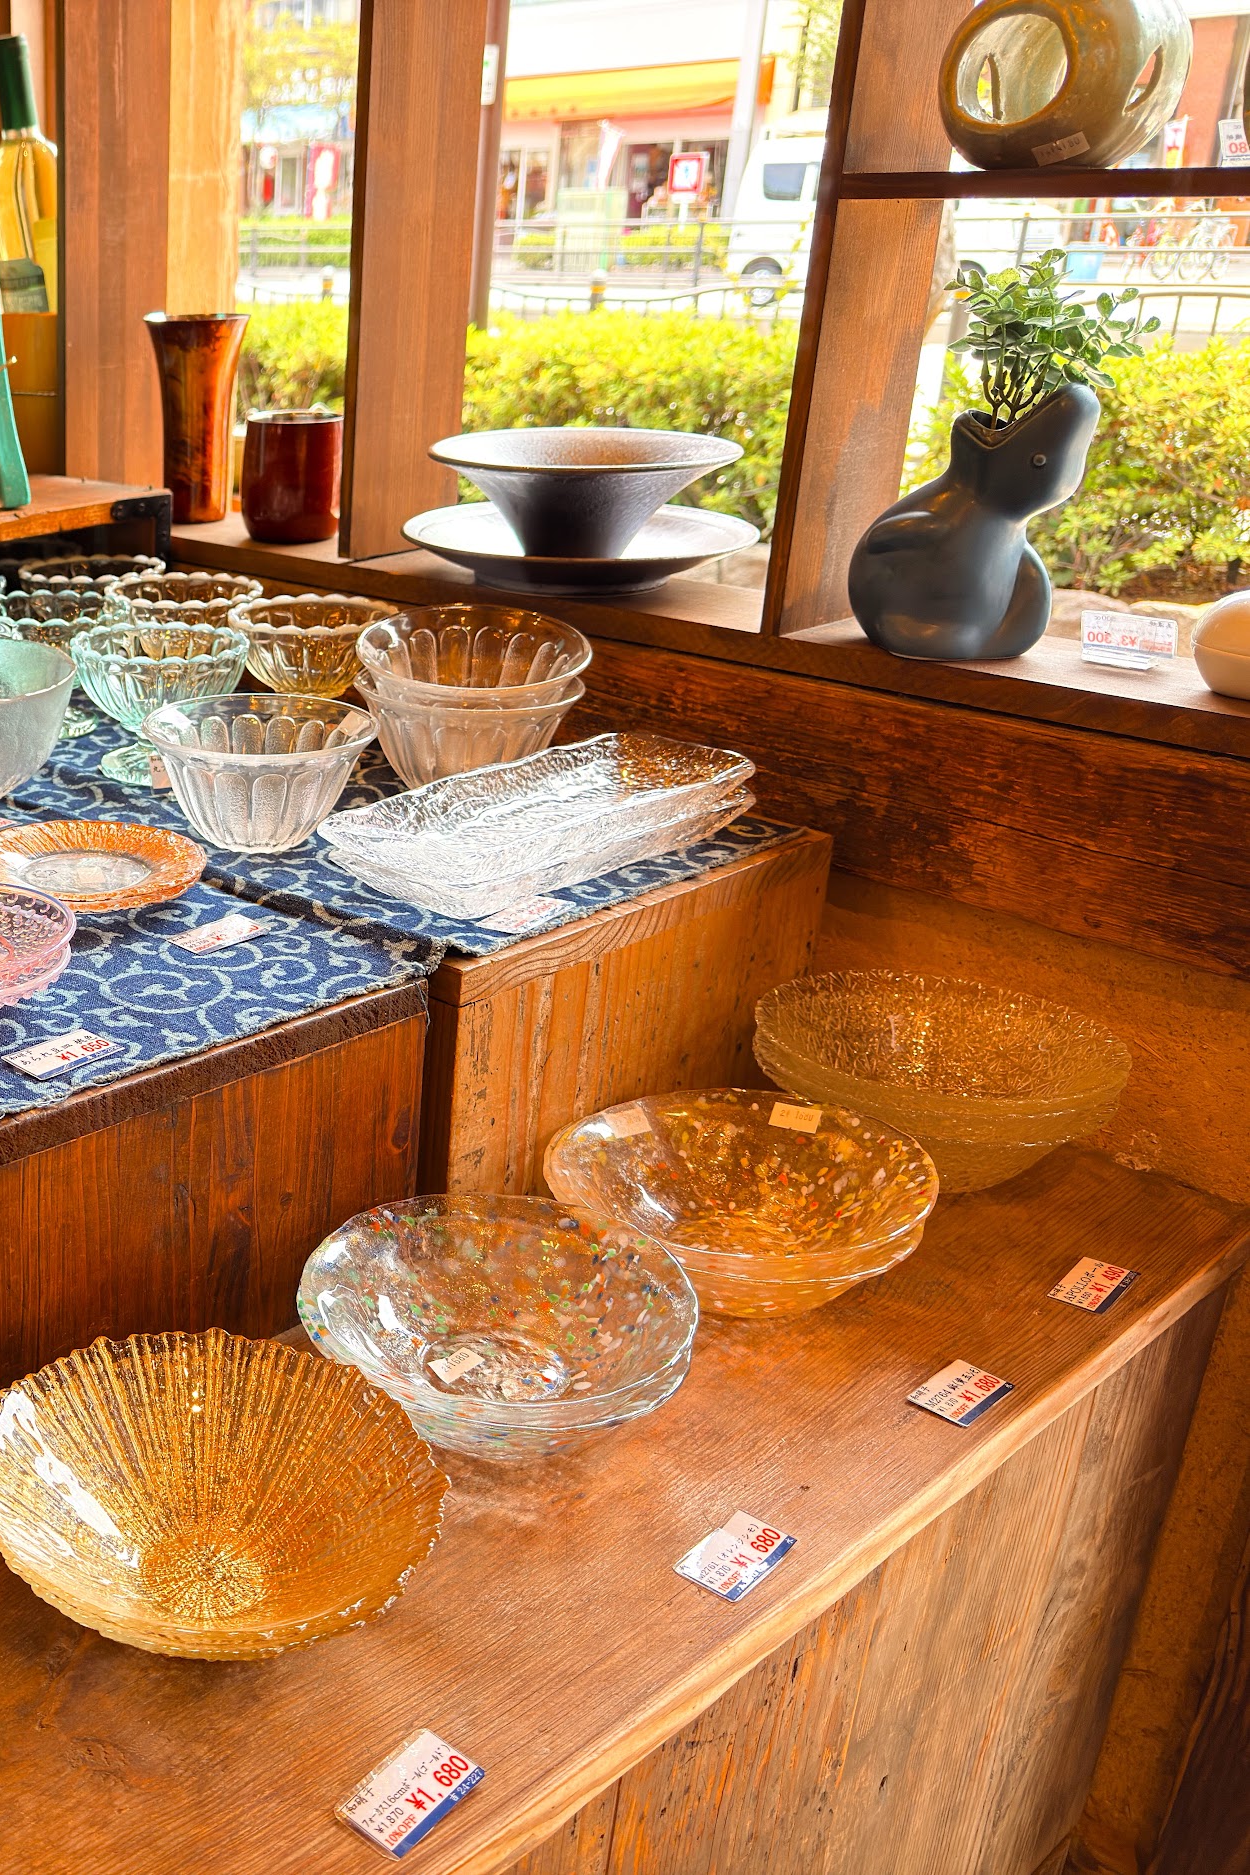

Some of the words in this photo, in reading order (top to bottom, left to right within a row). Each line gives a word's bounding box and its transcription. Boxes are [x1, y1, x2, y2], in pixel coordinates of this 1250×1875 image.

[55, 1039, 110, 1061] ¥1,650
[1089, 1266, 1125, 1293] ¥1,490
[925, 1389, 952, 1409] M2764
[958, 1374, 1001, 1403] ¥1,680
[730, 1528, 781, 1568] ¥1,680
[706, 1565, 731, 1585] ¥1,870
[718, 1570, 743, 1593] 10%OFF
[405, 1755, 469, 1811] ¥1,680
[456, 1769, 483, 1795] 24-227
[345, 1787, 374, 1815] 和硝子
[374, 1807, 404, 1834] ¥1,870
[384, 1813, 418, 1847] 10%OFF
